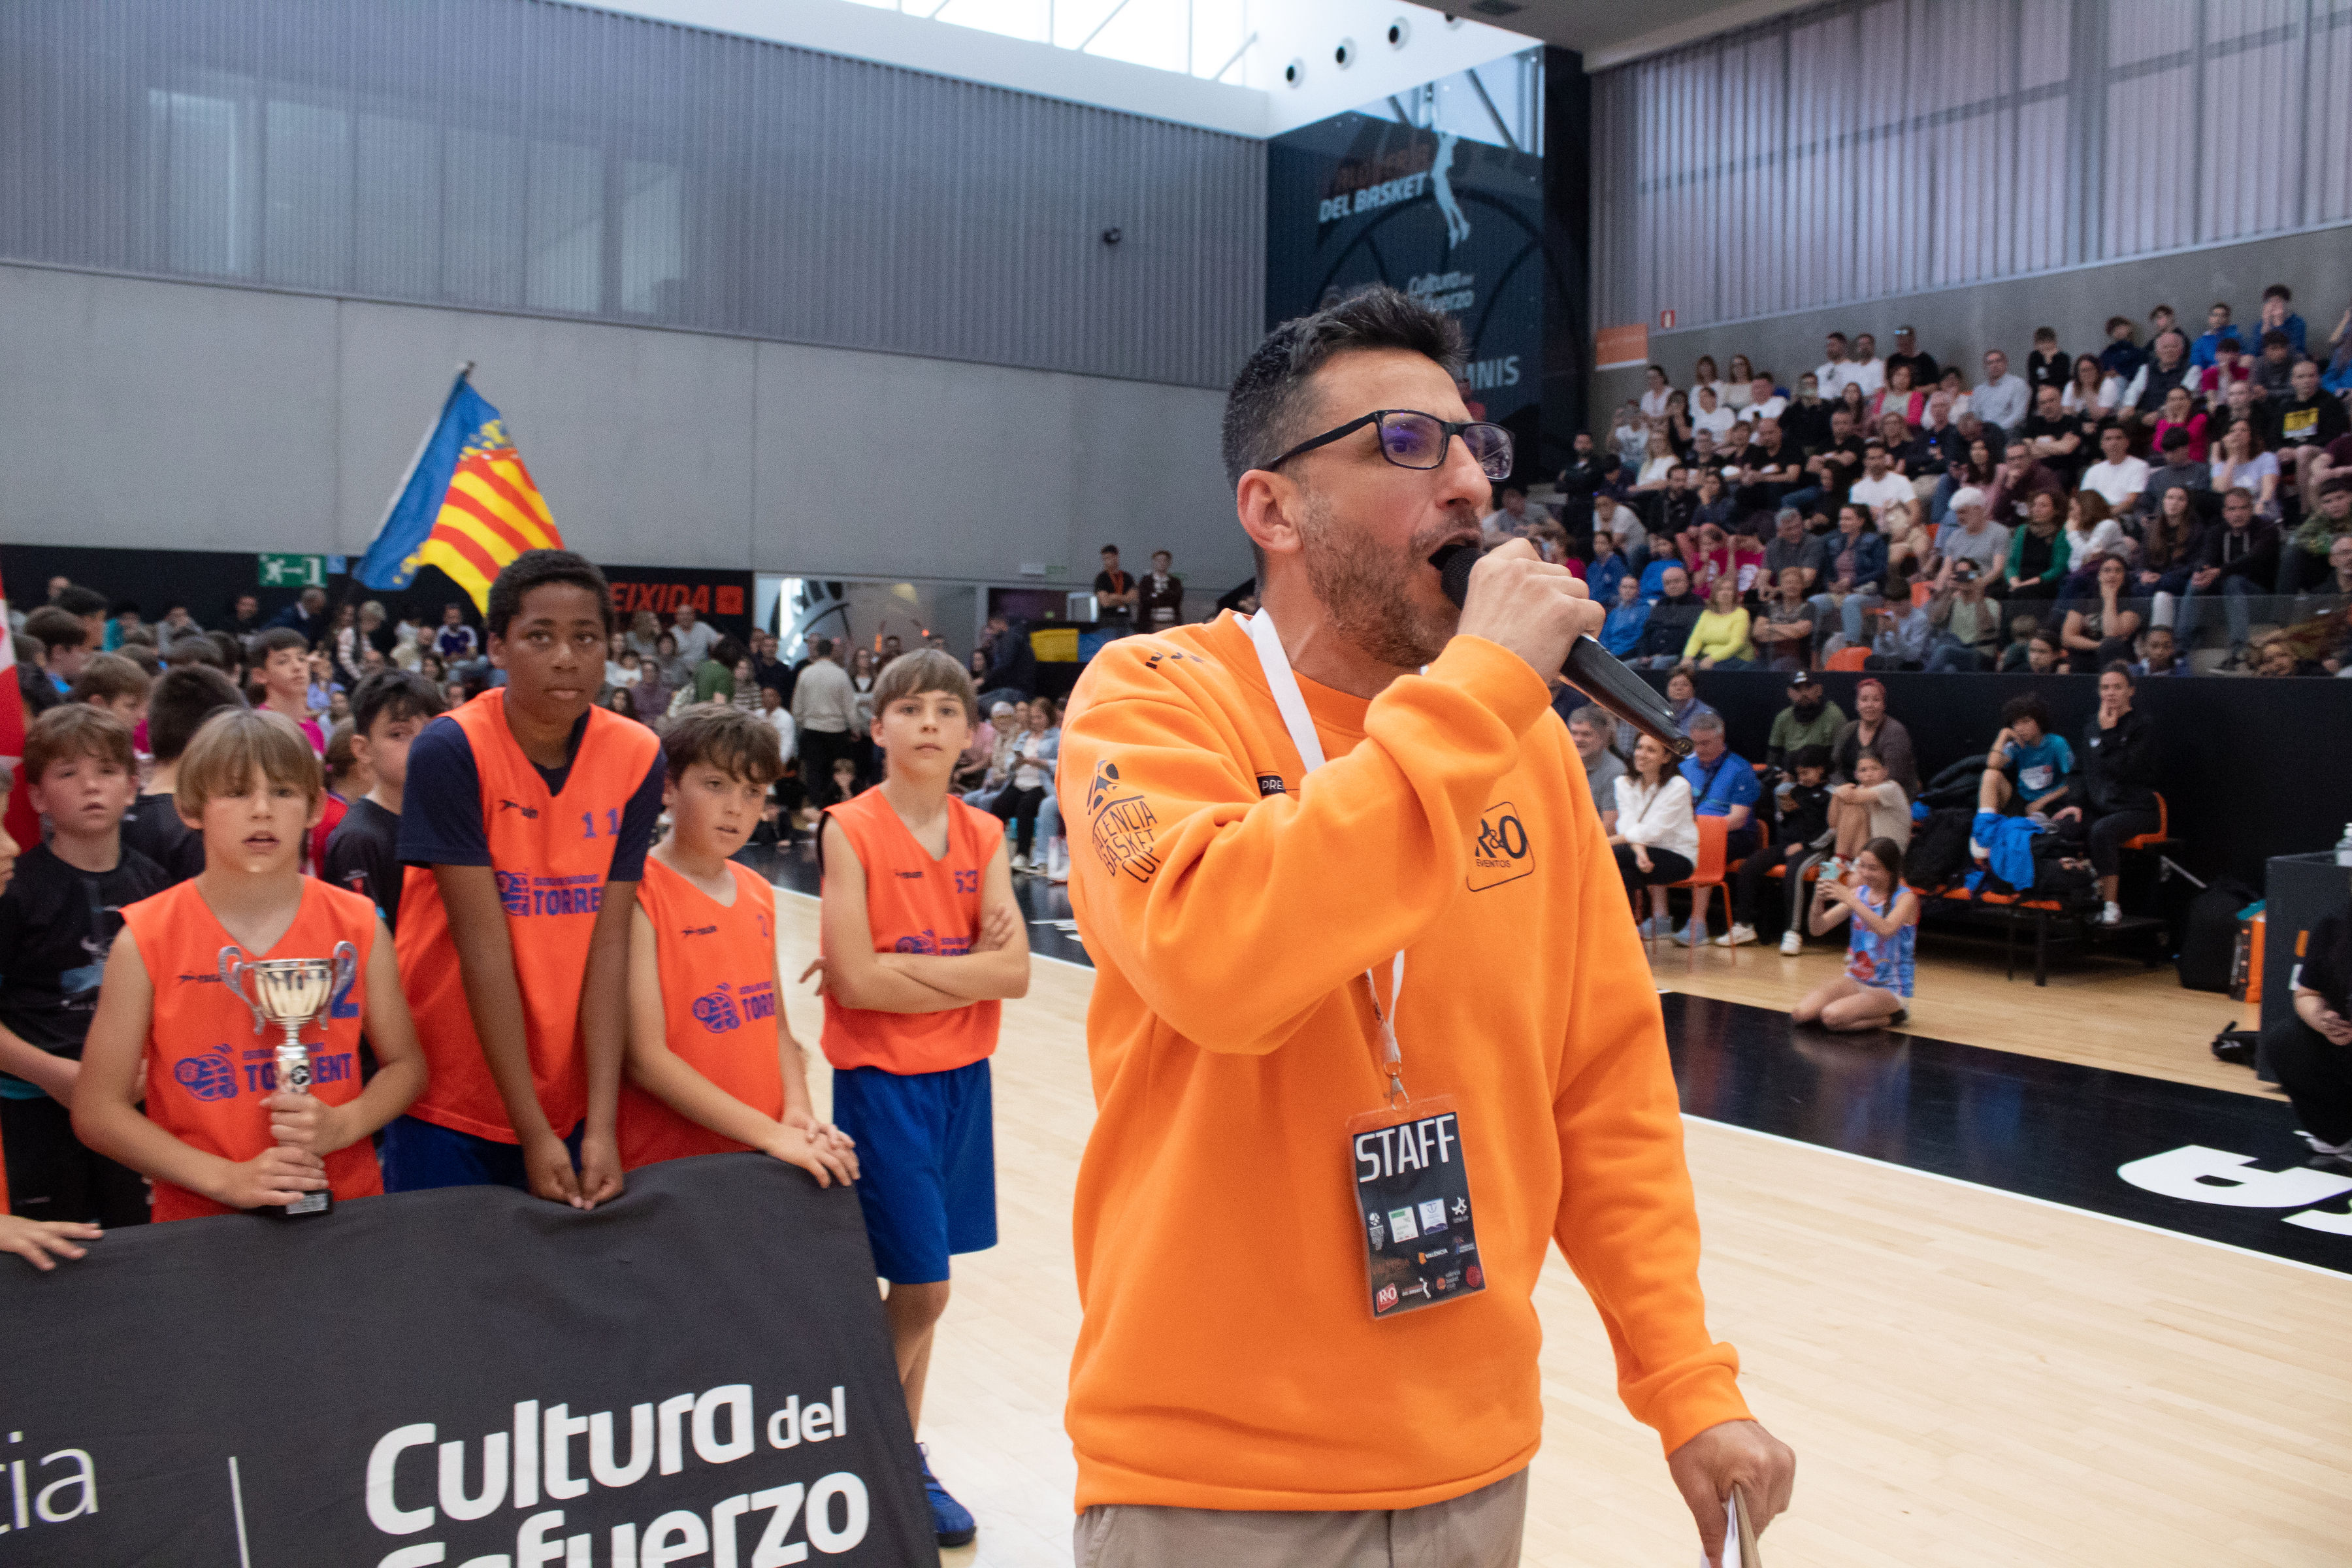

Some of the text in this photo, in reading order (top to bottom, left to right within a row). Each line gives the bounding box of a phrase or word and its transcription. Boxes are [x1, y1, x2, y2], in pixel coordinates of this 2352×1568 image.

[1318, 171, 1428, 223] DEL BASKET
[244, 1053, 352, 1099] TOENT
[1355, 1115, 1455, 1183] STAFF
[0, 1431, 98, 1529] ia
[366, 1384, 847, 1535] Cultura del
[376, 1472, 869, 1568] fuerzo
